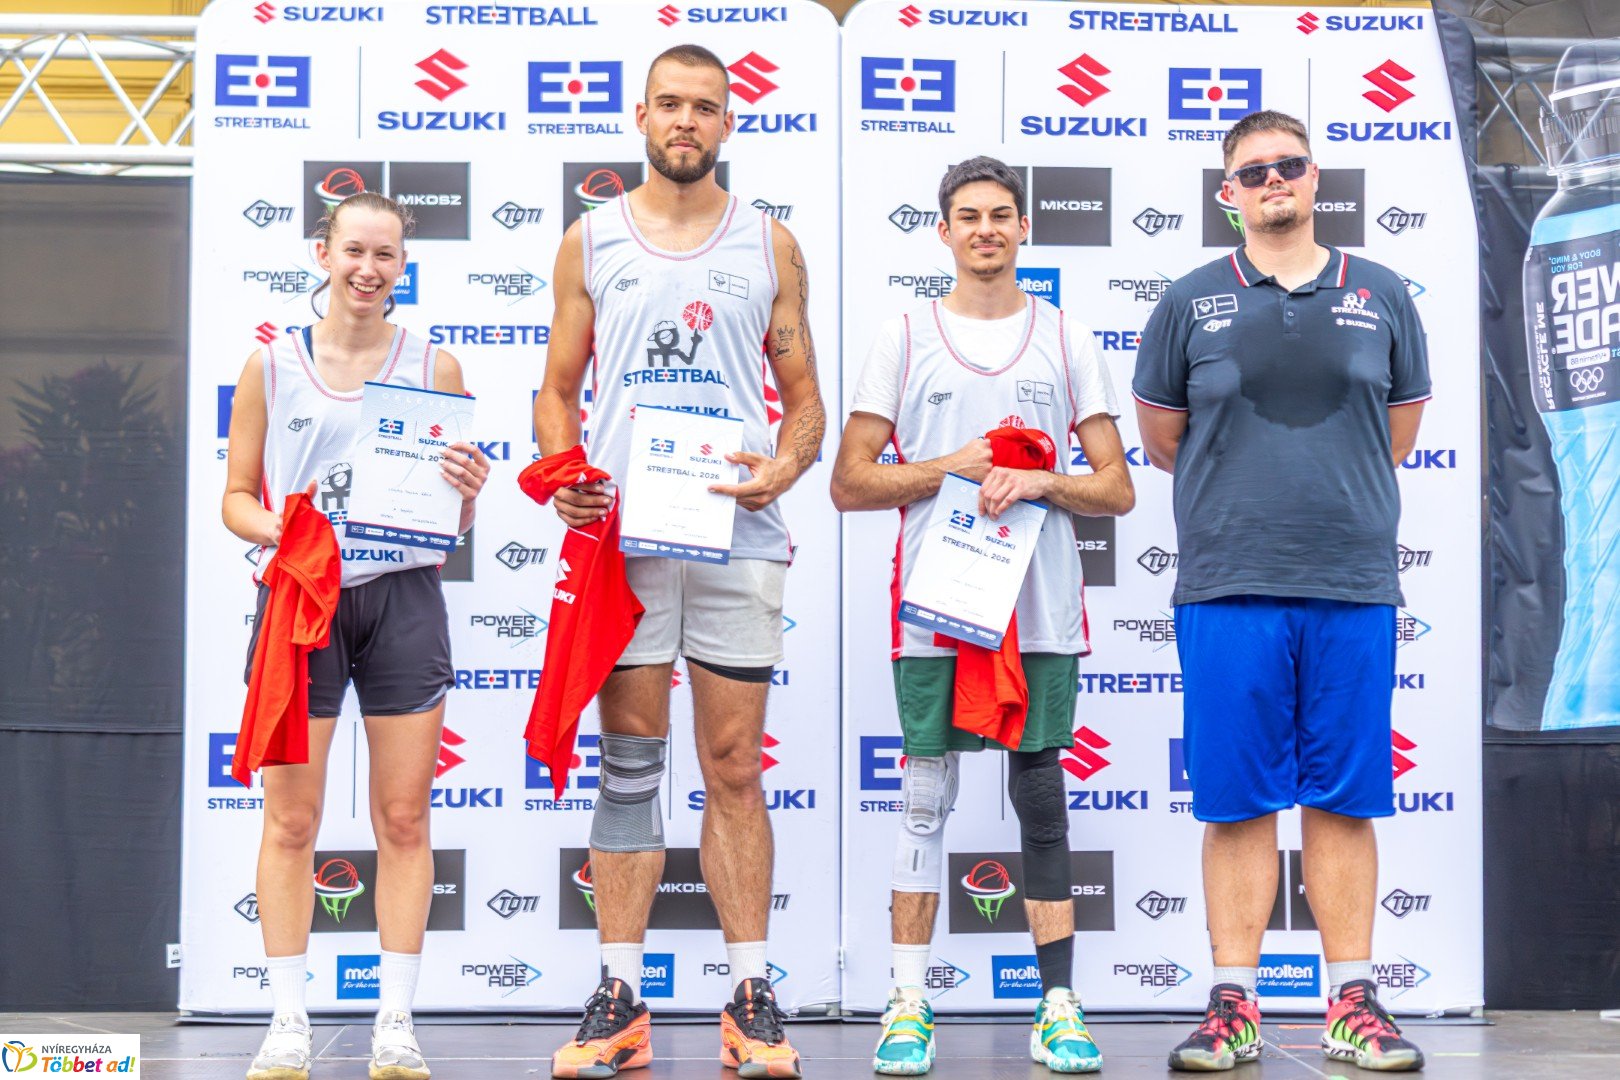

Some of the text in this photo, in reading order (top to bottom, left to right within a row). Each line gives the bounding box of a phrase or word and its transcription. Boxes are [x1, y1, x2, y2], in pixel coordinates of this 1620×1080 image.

[283, 6, 384, 22] SUZUKI
[687, 6, 788, 23] SUZUKI
[928, 9, 1028, 27] SUZUKI
[1325, 15, 1424, 31] SUZUKI
[377, 111, 506, 131] SUZUKI
[733, 113, 817, 133] ZUKI
[1020, 116, 1147, 137] SUZUKI
[1326, 121, 1451, 142] SUZUKI
[397, 194, 462, 206] MKOSZ
[1040, 199, 1103, 211] MKOSZ
[1313, 201, 1356, 212] KOSZ
[254, 206, 295, 222] TOTI
[503, 207, 545, 223] TOTI
[899, 211, 940, 227] TOTI
[1388, 212, 1427, 229] TOTI
[1144, 214, 1184, 230] TOTI
[244, 271, 309, 283] POWER
[468, 274, 533, 285] POWER
[889, 275, 953, 287] POWER
[270, 282, 308, 293] ADE
[495, 285, 532, 296] ADE
[1016, 277, 1052, 292] olten
[1345, 319, 1377, 331] SUZUKI
[429, 325, 550, 345] STREETB
[418, 437, 449, 448] SUZUK
[689, 455, 722, 466] SUZUKI
[1402, 449, 1456, 468] UKI
[699, 471, 720, 480] 2026
[985, 535, 1017, 551] SUZUKI
[341, 549, 404, 563] UZUKI
[507, 548, 548, 565] TOTI
[991, 552, 1011, 565] 2026
[1150, 553, 1178, 569] TOT
[471, 615, 536, 627] POWER
[497, 626, 535, 638] ADE
[1140, 631, 1176, 642] ADE
[431, 788, 503, 808] ZUKI
[687, 789, 816, 811] SUKI
[1068, 790, 1148, 810] ZUKI
[1393, 791, 1453, 812] UKI
[656, 883, 709, 893] MKOS
[1071, 885, 1105, 896] OSZ
[500, 895, 541, 911] TOTI
[1148, 897, 1188, 913] TOTI
[1392, 895, 1432, 911] TOTI
[462, 964, 528, 976] POWER
[1113, 964, 1178, 976] POWER
[1258, 965, 1313, 978] molten
[1372, 964, 1416, 975] WER
[489, 976, 526, 987] ADE
[1141, 975, 1177, 987] ADE
[1376, 976, 1415, 988] ADE
